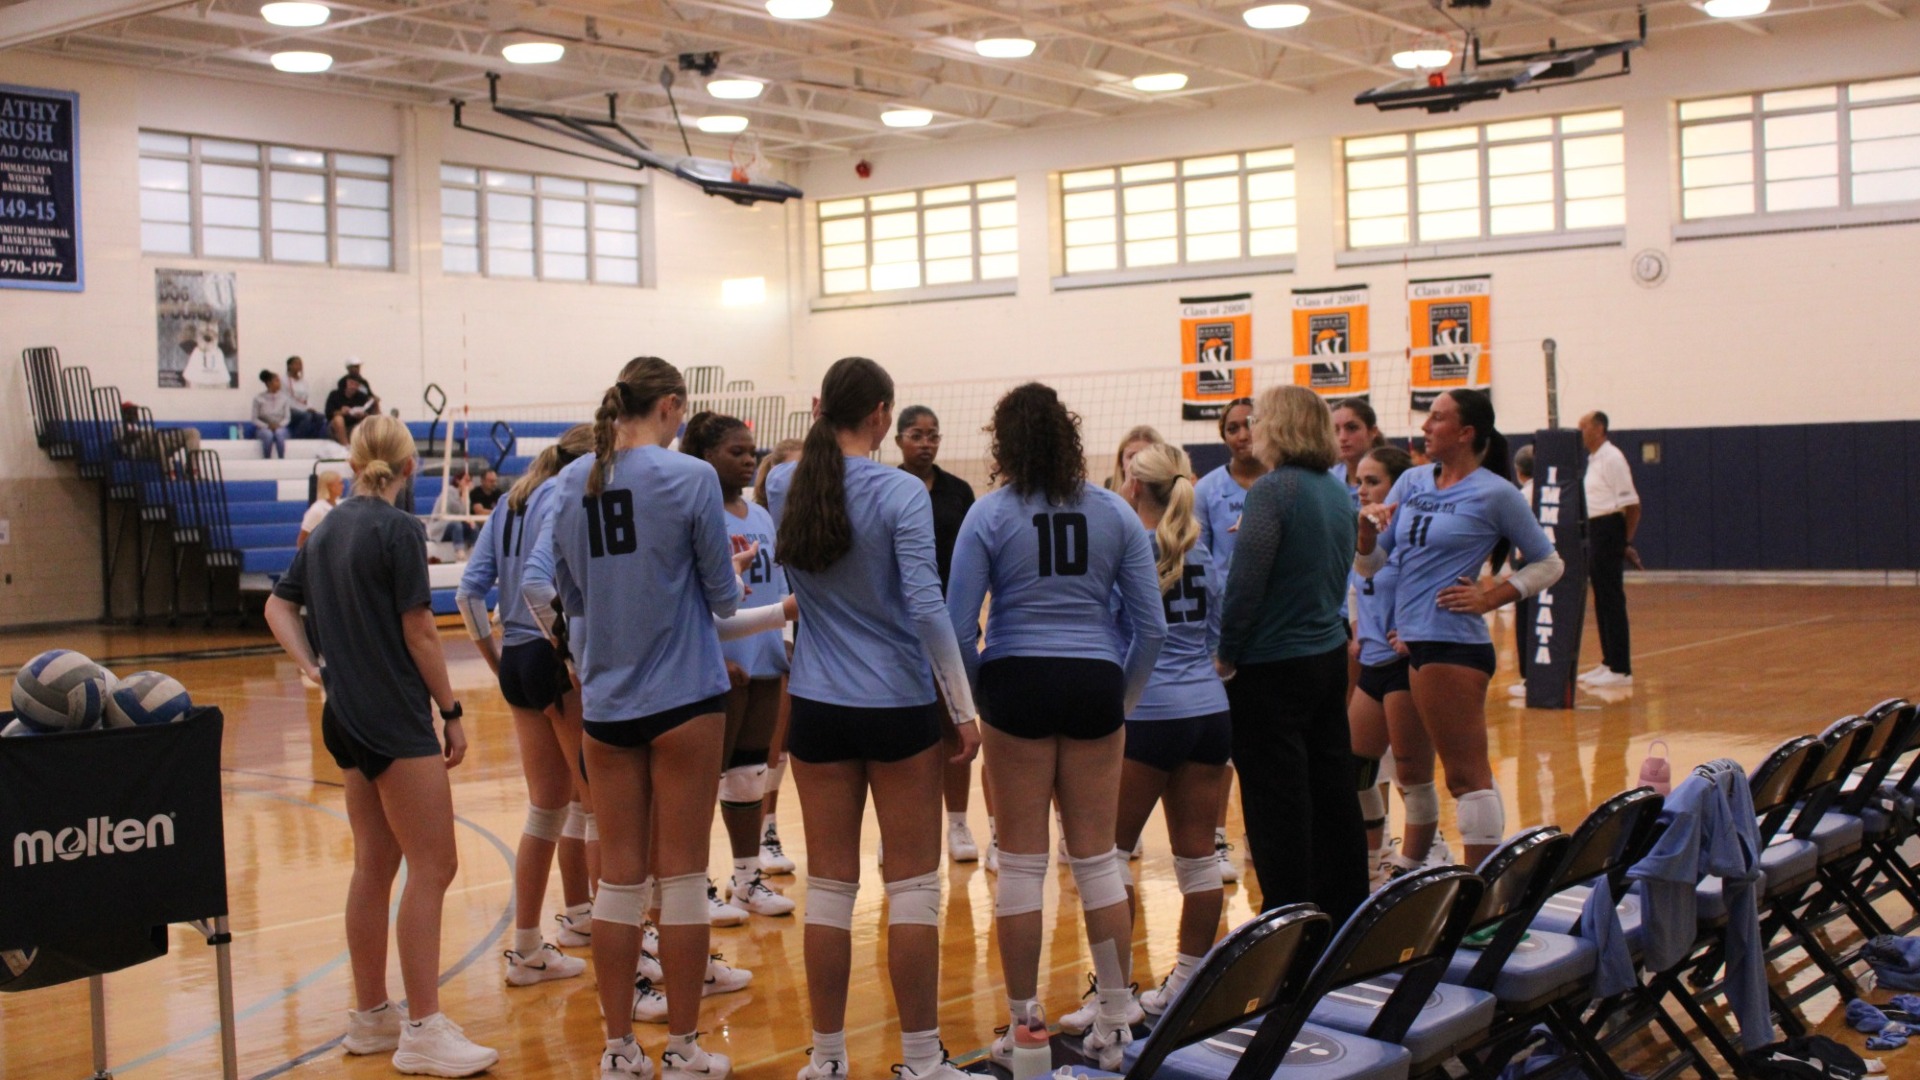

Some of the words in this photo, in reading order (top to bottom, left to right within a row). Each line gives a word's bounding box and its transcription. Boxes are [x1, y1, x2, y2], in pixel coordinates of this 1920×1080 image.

[2, 99, 59, 122] ATHY
[0, 119, 53, 142] RUSH
[22, 147, 68, 162] COACH
[1, 162, 51, 175] IMMACULATA
[2, 182, 51, 195] BASKETBALL
[0, 198, 56, 221] 149-15
[26, 226, 70, 239] MEMORIAL
[2, 234, 52, 248] BASKETBALL
[22, 247, 33, 256] OF
[34, 247, 57, 258] FAME
[1414, 286, 1441, 297] Class
[1443, 284, 1455, 295] of
[1456, 282, 1484, 294] 2002
[1296, 297, 1321, 307] Class
[1323, 296, 1334, 305] of
[1183, 306, 1207, 316] Class
[1210, 305, 1220, 315] of
[582, 489, 637, 558] 18
[1409, 515, 1433, 547] 11
[1032, 512, 1089, 578] 10
[750, 548, 771, 584] 21
[1535, 466, 1561, 665] IMMALATA
